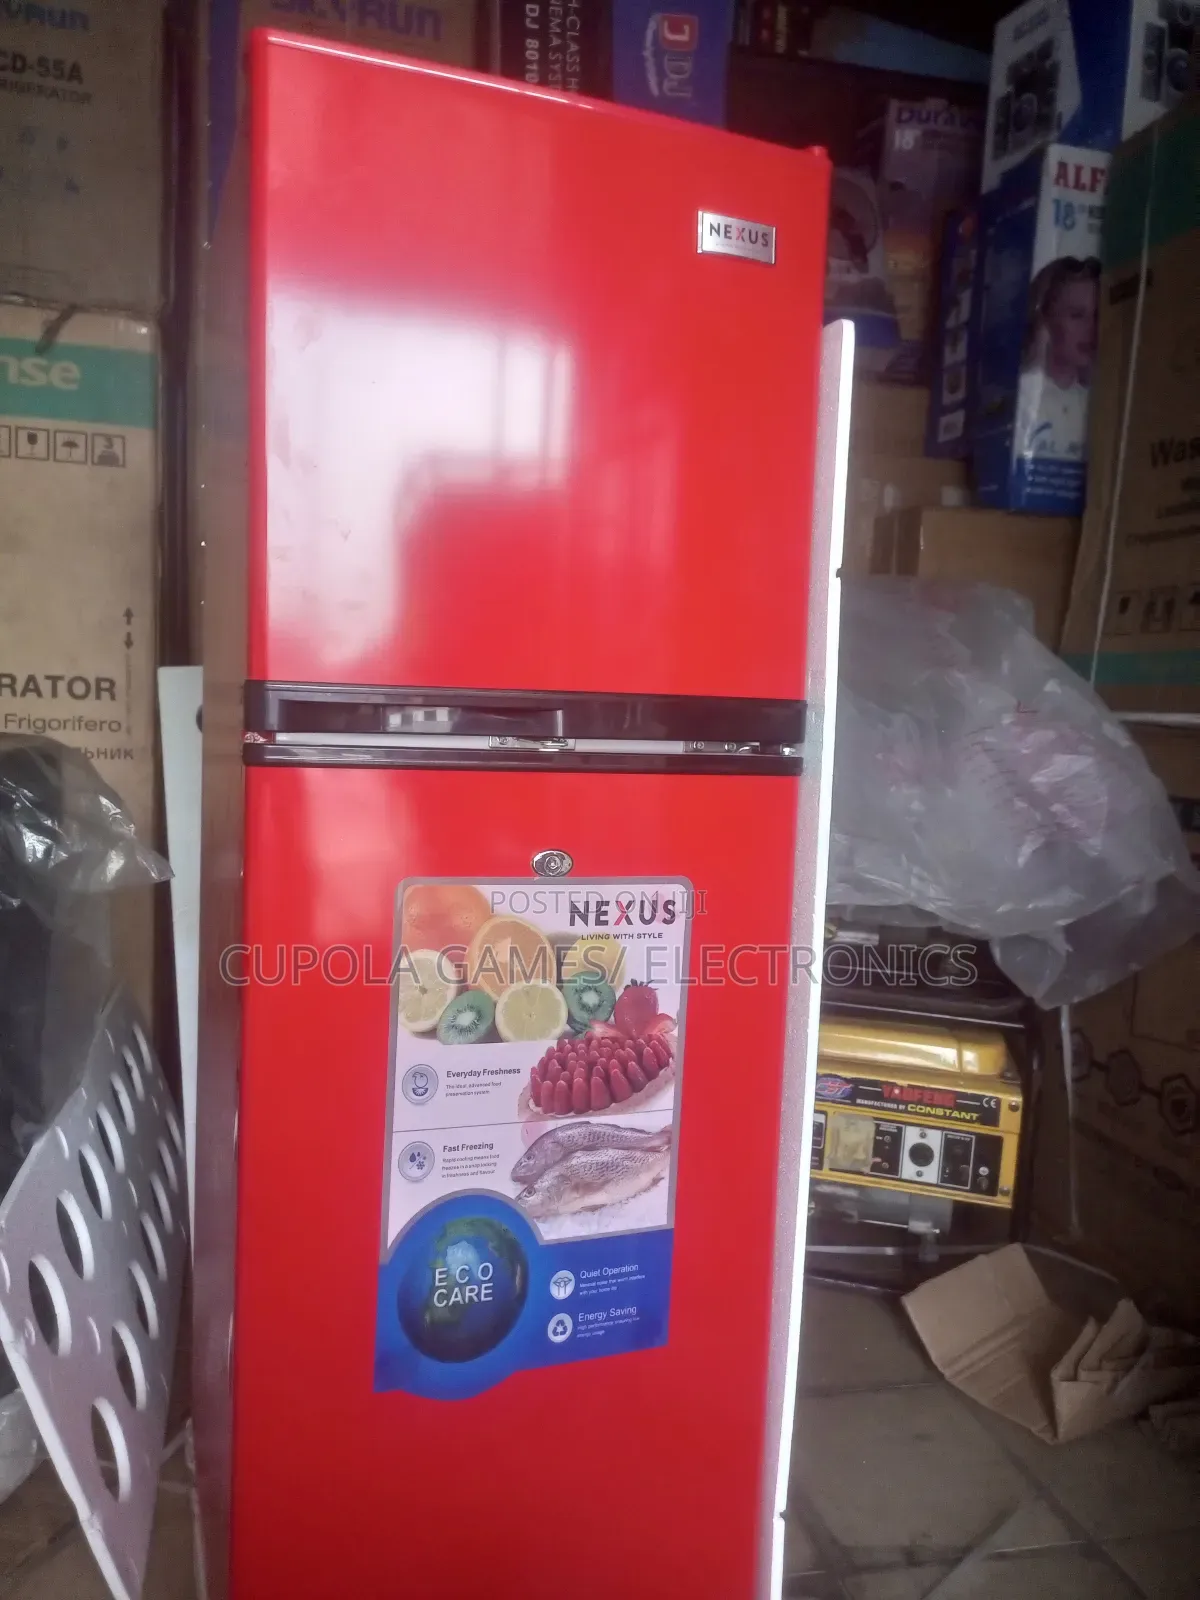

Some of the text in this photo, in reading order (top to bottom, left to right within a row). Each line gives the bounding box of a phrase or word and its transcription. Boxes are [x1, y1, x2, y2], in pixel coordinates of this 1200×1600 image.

[709, 222, 769, 247] NEXUS
[0, 673, 117, 701] RATOR
[4, 713, 122, 735] Frigorifero
[569, 899, 676, 927] NEXUS
[581, 933, 611, 941] LIVING
[446, 1067, 521, 1079] Everyday Freshness
[907, 1104, 979, 1121] CONSTANT
[442, 1142, 494, 1153] Fast Freezing
[580, 1264, 639, 1279] Quiet Operation
[433, 1283, 494, 1308] CARE
[578, 1306, 637, 1323] Energy Saving
